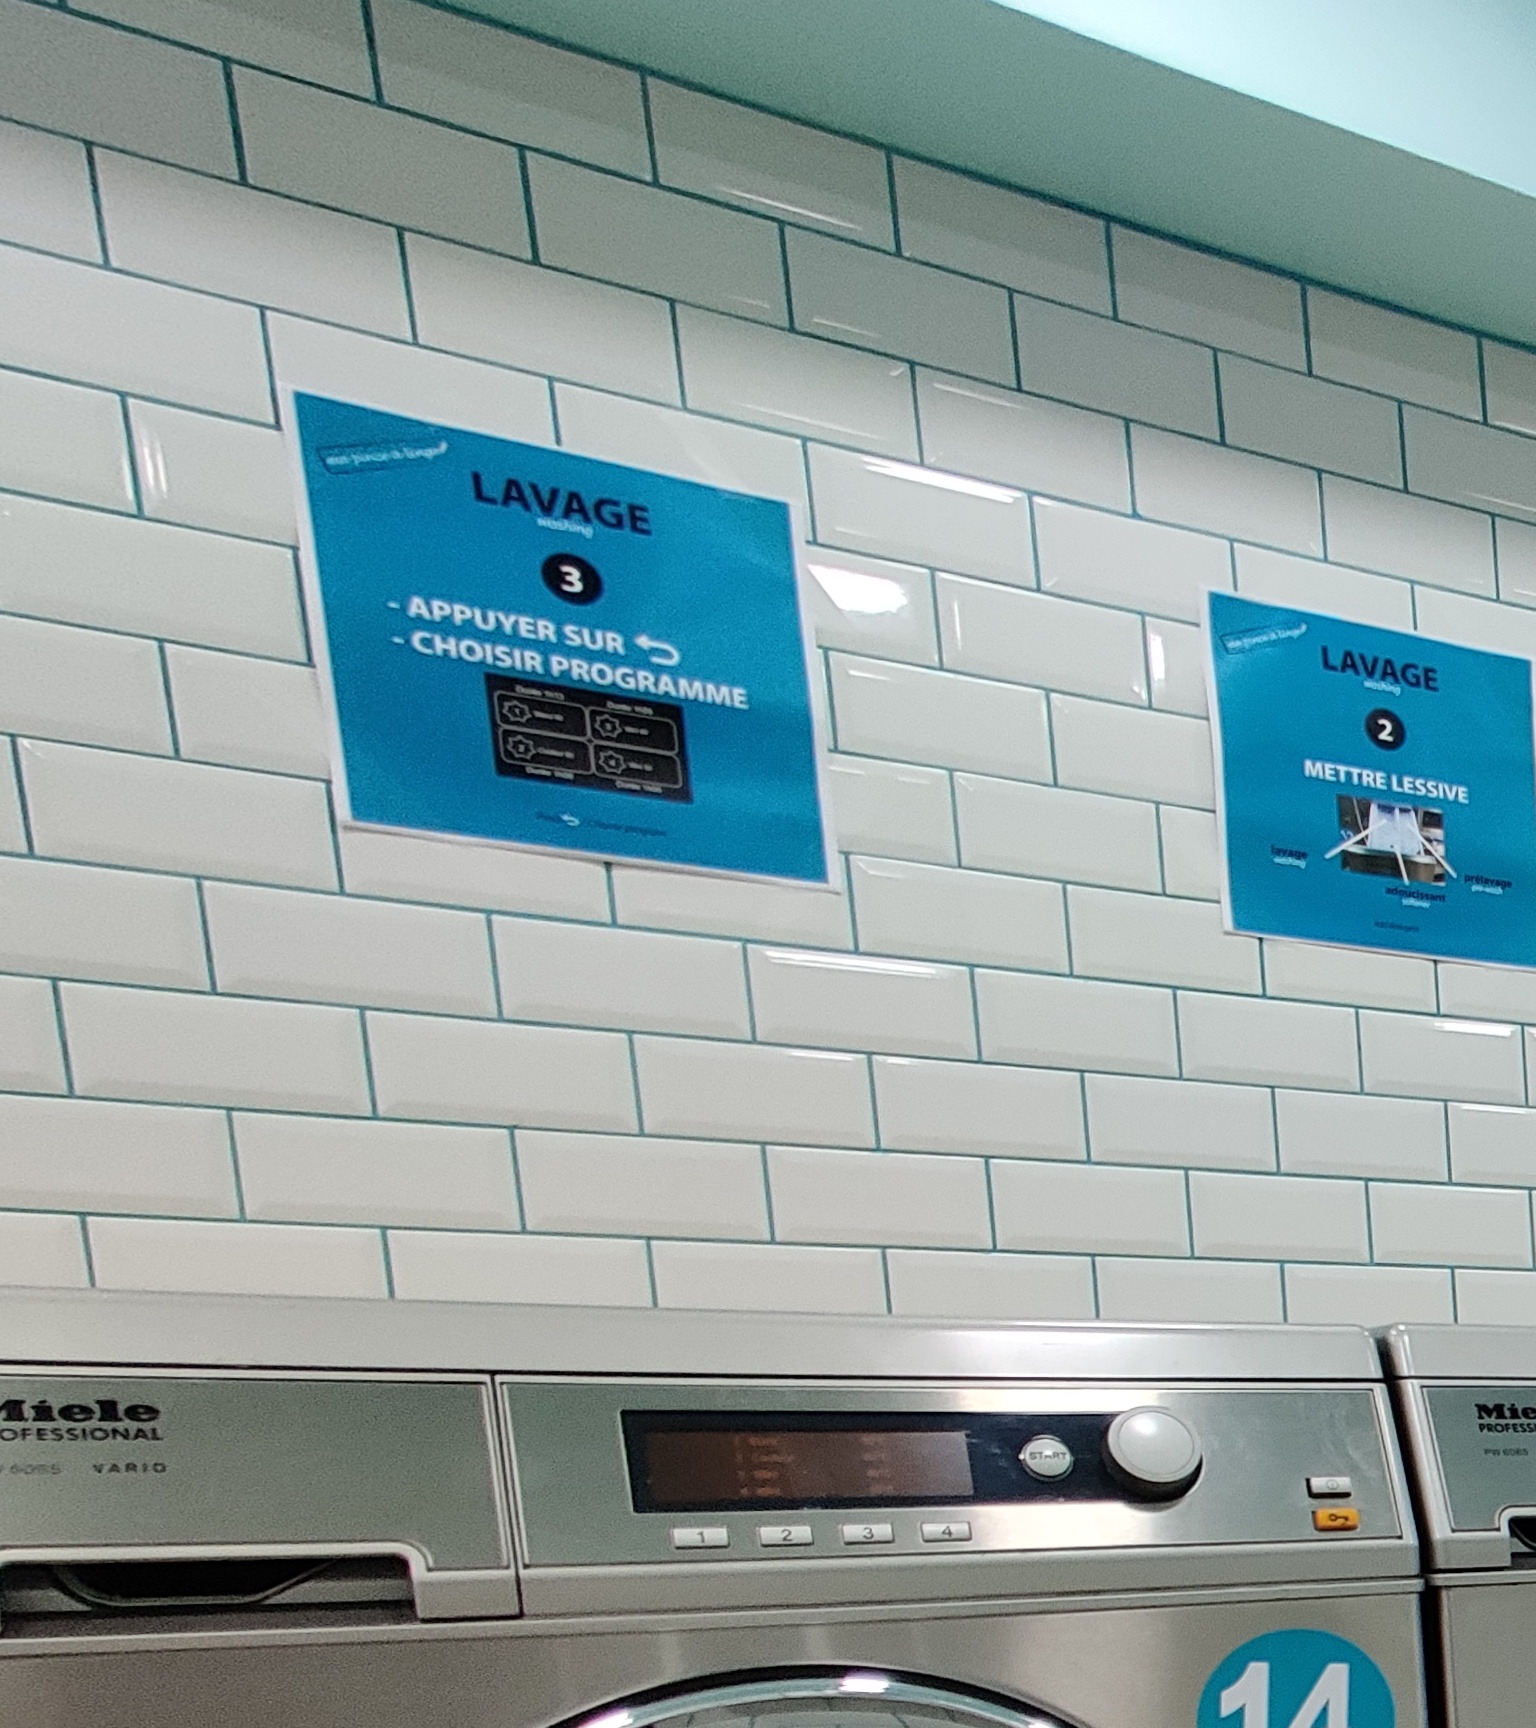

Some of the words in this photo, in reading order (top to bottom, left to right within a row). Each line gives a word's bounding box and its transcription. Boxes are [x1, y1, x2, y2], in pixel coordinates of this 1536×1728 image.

[470, 470, 653, 537] LAVAGE
[557, 563, 584, 593] 3
[407, 596, 557, 645] APPUYER
[563, 626, 626, 656] SUR
[410, 632, 544, 676] CHOISIR
[550, 655, 750, 710] PROGRAMME
[1320, 645, 1440, 693] LAVAGE
[1377, 718, 1395, 742] 2
[1303, 759, 1387, 791] METTRE
[1391, 774, 1469, 804] LESSIVE
[93, 1462, 167, 1474] VARIO
[1029, 1451, 1067, 1461] START
[697, 1531, 706, 1544] 1
[781, 1529, 793, 1542] 2
[862, 1528, 875, 1540] 3
[940, 1526, 954, 1538] 4
